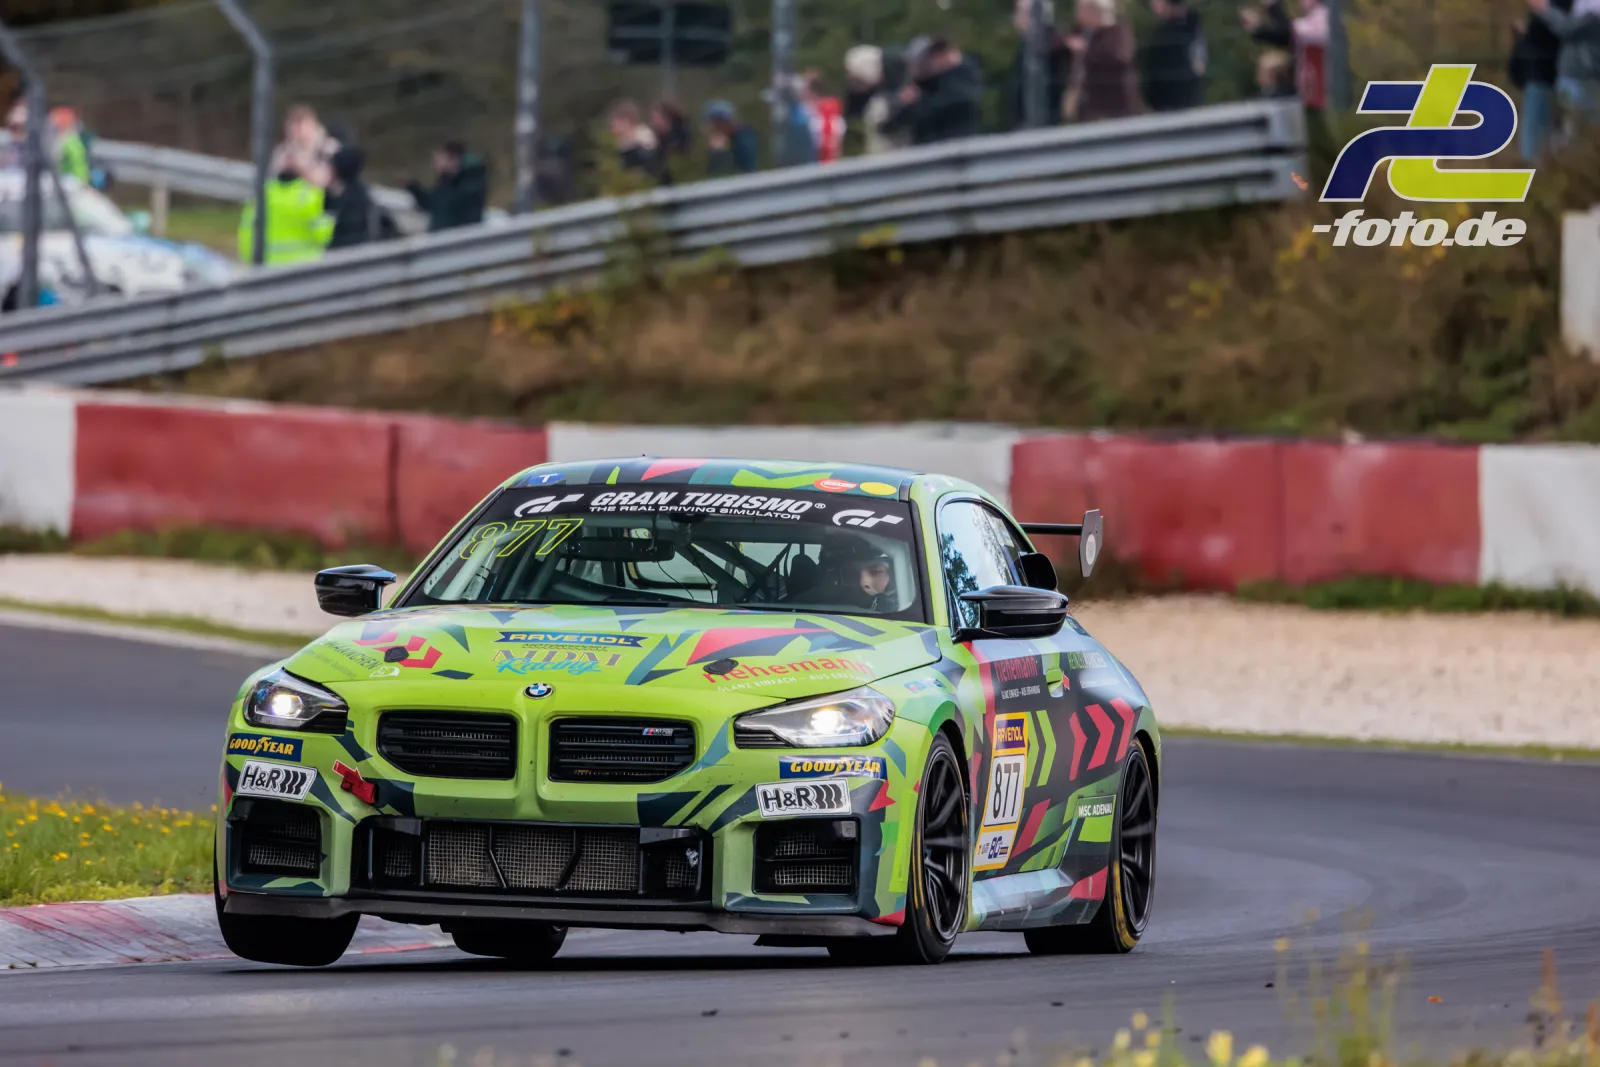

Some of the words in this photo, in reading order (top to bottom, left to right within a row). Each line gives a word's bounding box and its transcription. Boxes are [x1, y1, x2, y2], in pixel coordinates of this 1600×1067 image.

[591, 491, 678, 506] GRAN
[719, 508, 801, 520] SIMULATOR
[460, 518, 584, 560] 877
[509, 633, 634, 645] RAVENOL
[496, 657, 602, 676] Racing
[997, 726, 1023, 743] RAVENOL
[241, 765, 282, 789] H&R
[761, 786, 815, 811] H&R
[992, 762, 1021, 819] 877
[1078, 804, 1092, 817] MSC
[1092, 802, 1113, 816] ADENAU
